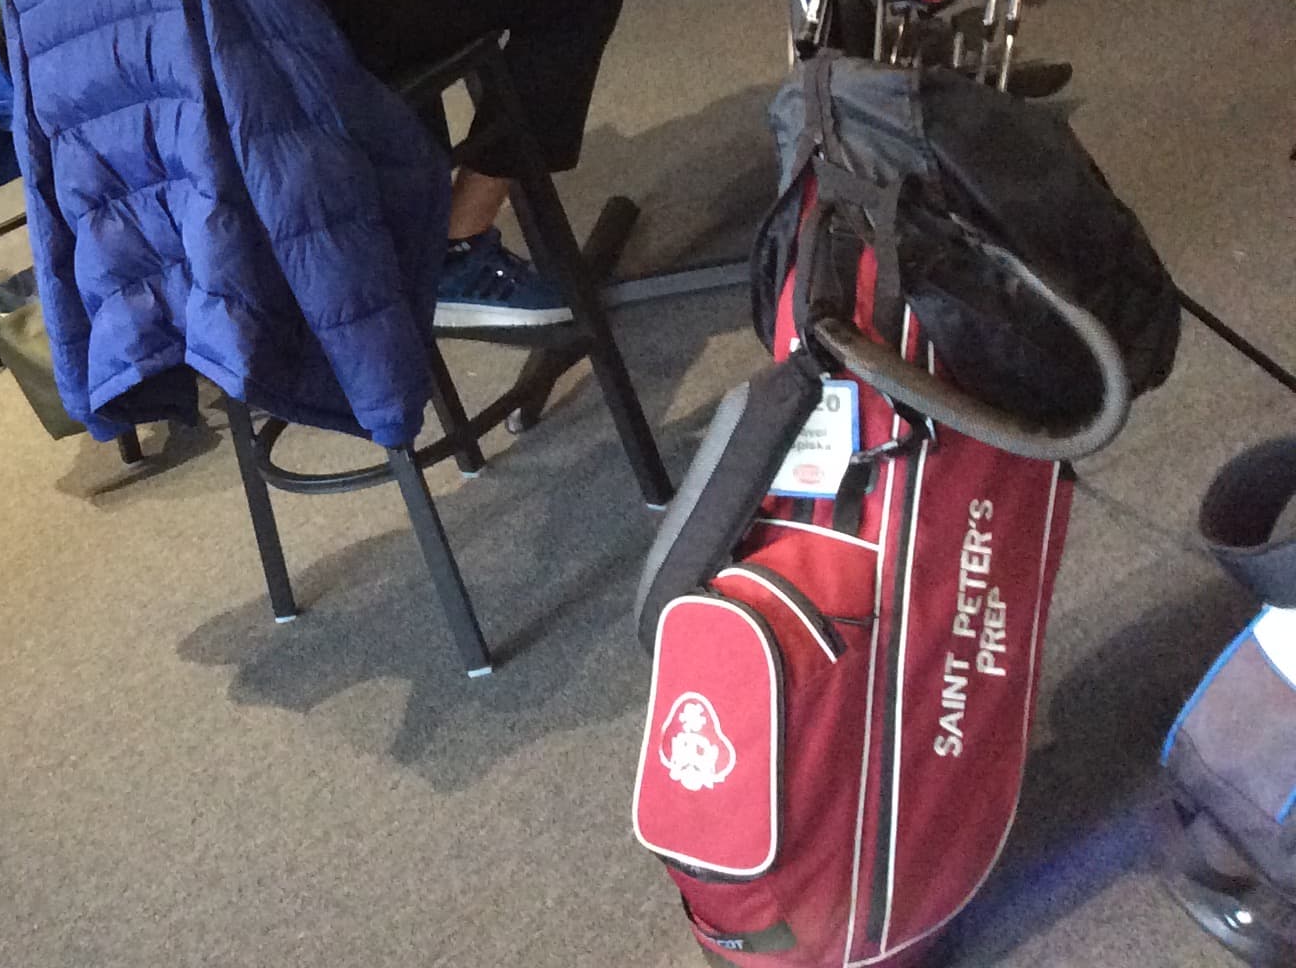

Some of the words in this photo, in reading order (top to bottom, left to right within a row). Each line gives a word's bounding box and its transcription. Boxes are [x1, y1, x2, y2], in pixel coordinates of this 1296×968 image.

[933, 652, 970, 758] SAINT
[953, 498, 994, 639] PETER'S
[975, 586, 1007, 677] PREP
